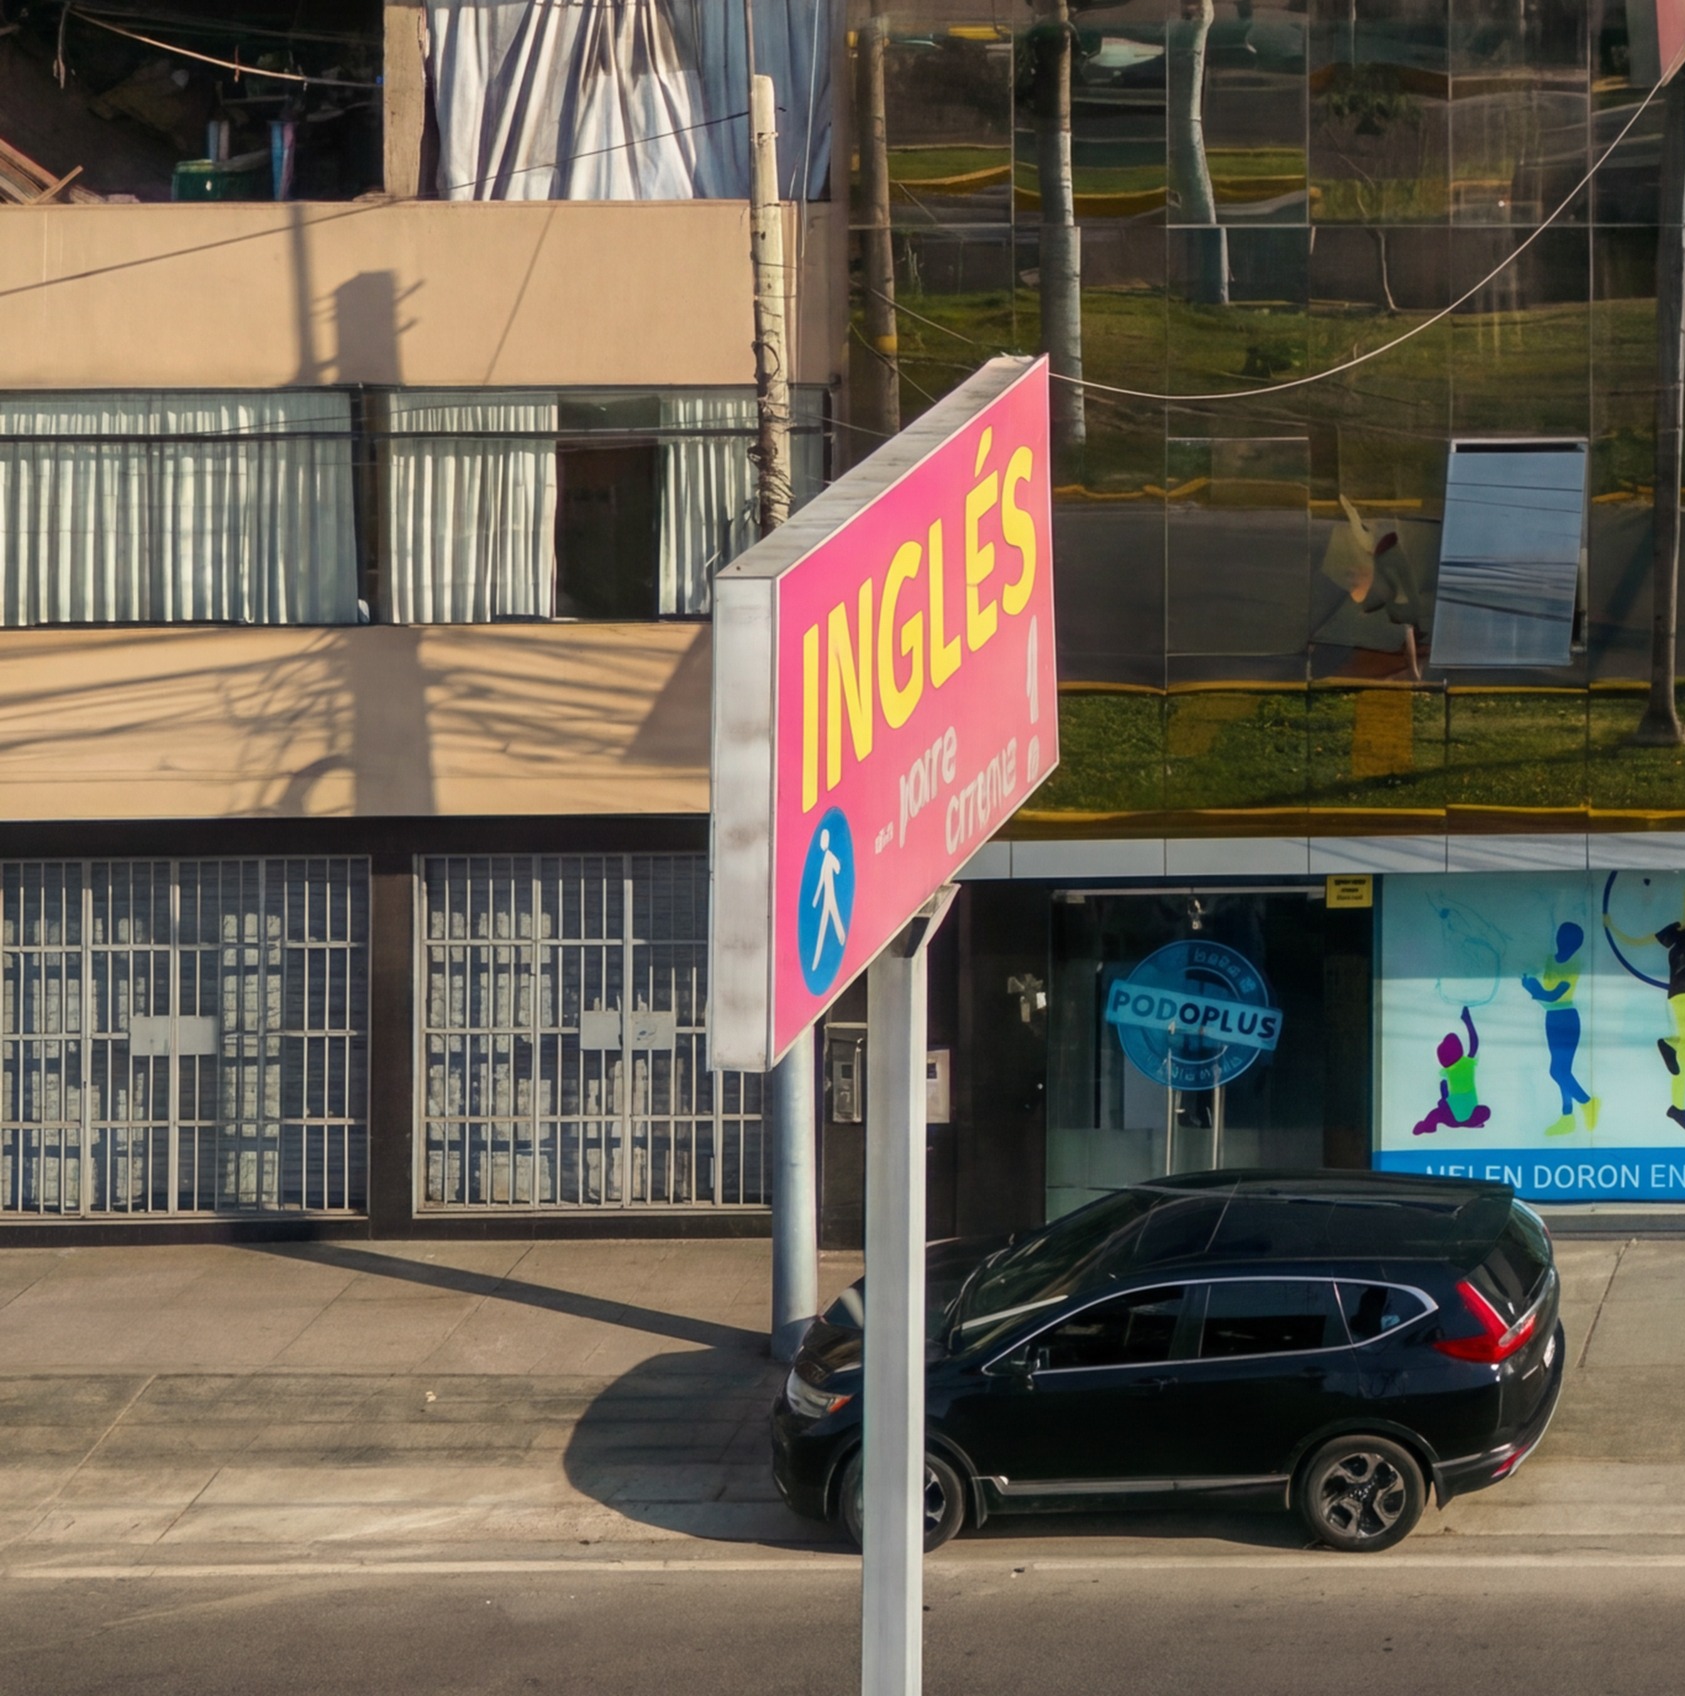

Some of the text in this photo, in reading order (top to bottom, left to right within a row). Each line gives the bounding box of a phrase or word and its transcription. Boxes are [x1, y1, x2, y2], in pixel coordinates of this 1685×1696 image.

[802, 425, 1037, 814] INGLÉS
[1112, 989, 1277, 1039] PODOPLUS
[1534, 1164, 1640, 1189] DORON
